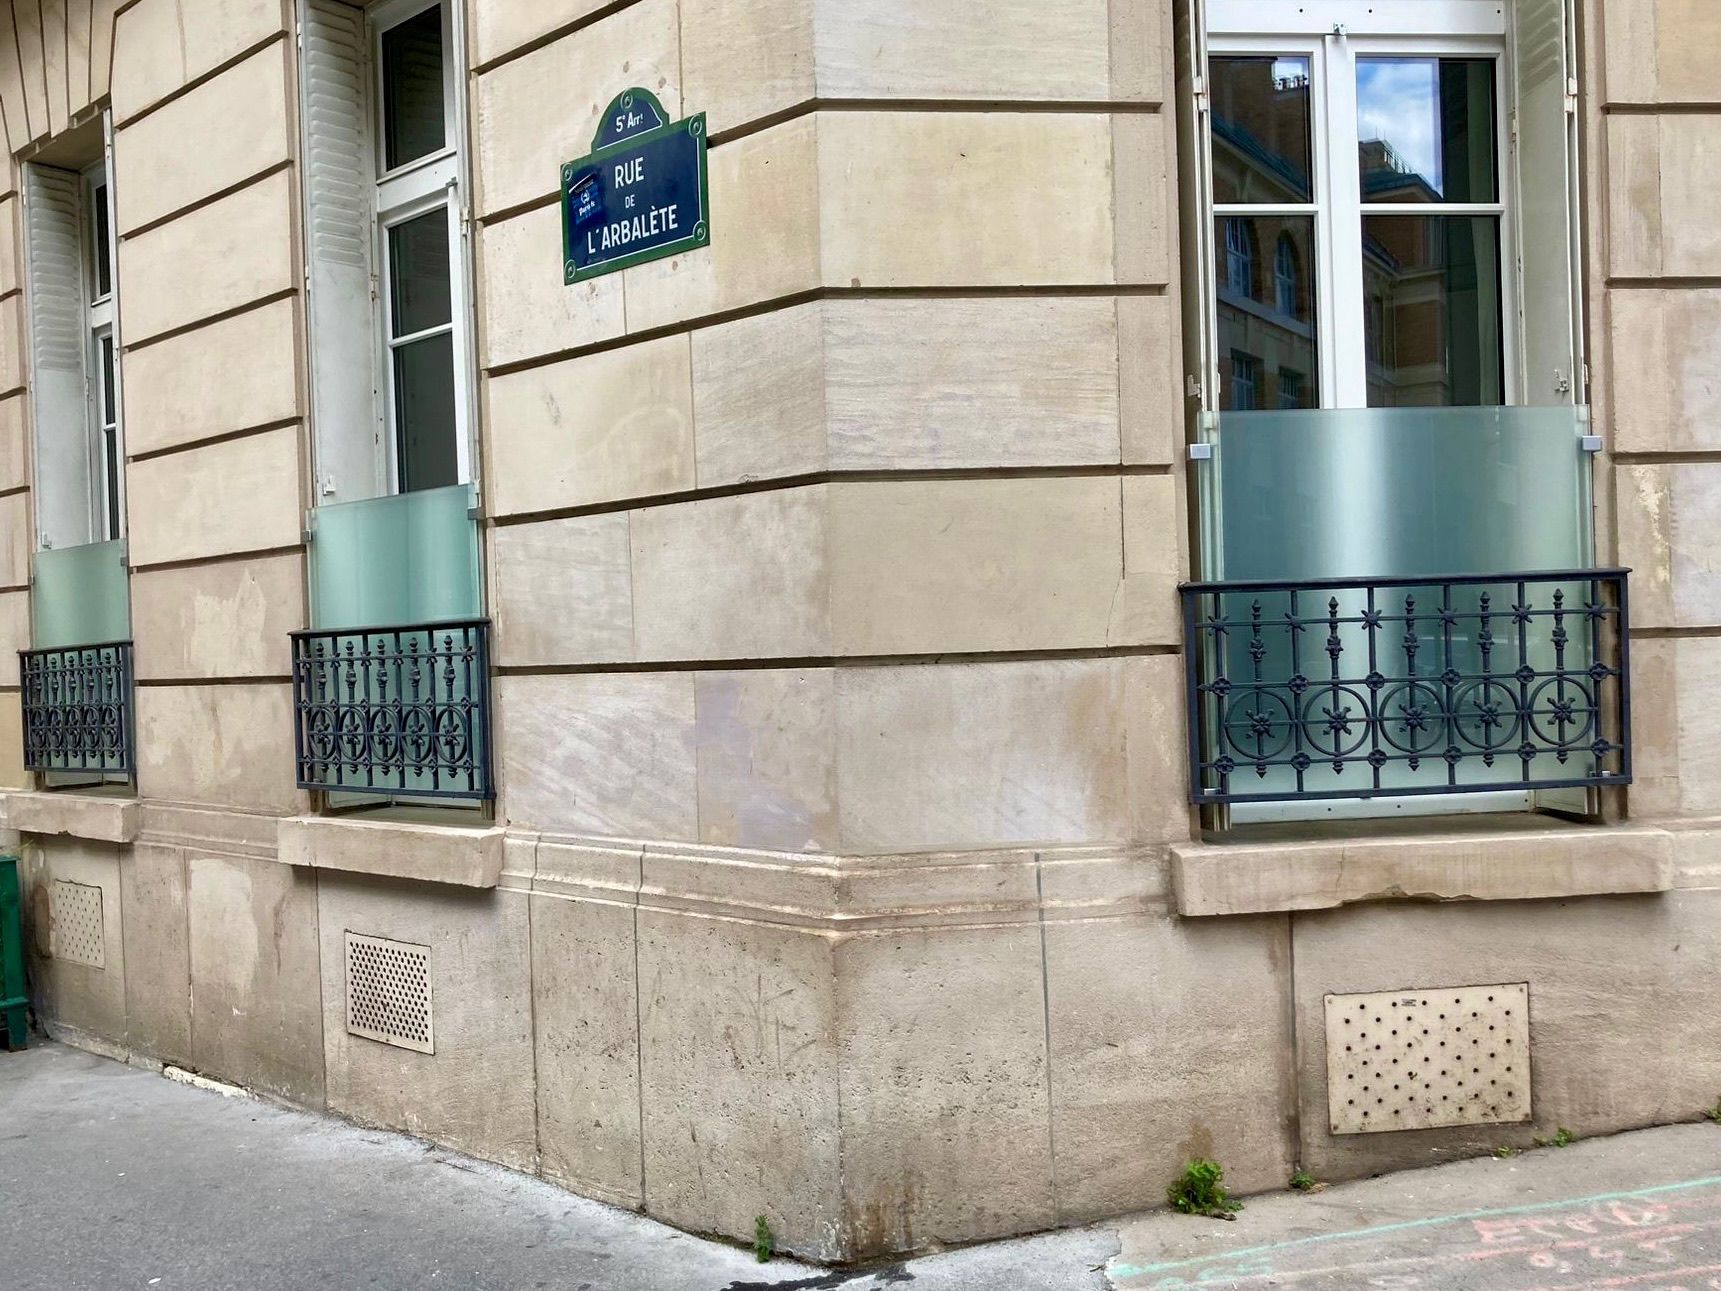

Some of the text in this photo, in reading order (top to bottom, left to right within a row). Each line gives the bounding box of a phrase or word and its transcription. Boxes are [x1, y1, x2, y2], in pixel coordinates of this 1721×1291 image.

[615, 157, 644, 189] RUE
[624, 194, 635, 209] DE
[587, 204, 678, 254] L'ARBALÈTE
